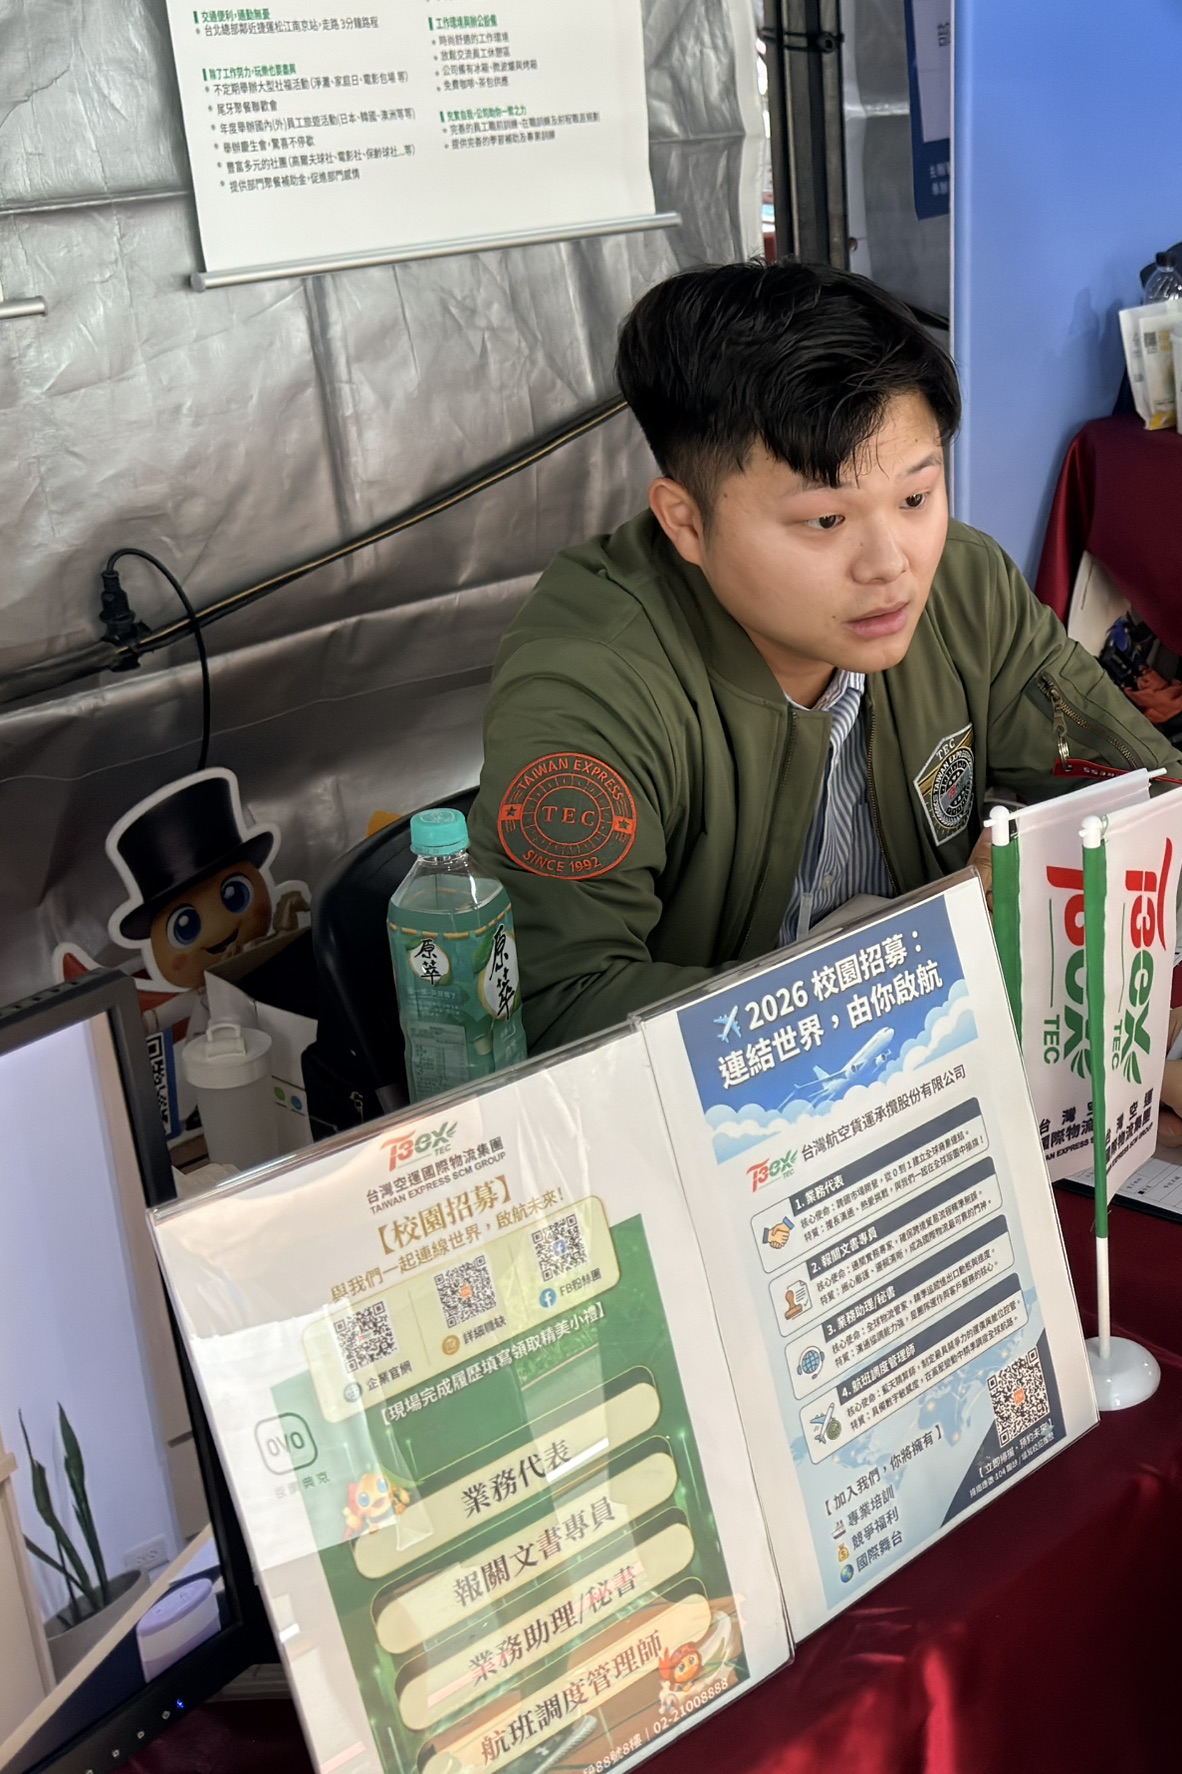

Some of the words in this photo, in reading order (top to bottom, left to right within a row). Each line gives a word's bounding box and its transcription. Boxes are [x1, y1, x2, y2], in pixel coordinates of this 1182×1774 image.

[217, 99, 277, 116] 尾牙聚餐聯歡會
[936, 738, 956, 760] TEC
[518, 758, 569, 792] TAIWAN
[574, 760, 624, 800] EXPRESS
[542, 806, 596, 827] TEC
[522, 850, 565, 872] SINCE
[569, 857, 602, 873] 1992
[414, 938, 441, 985] 原萃
[743, 978, 810, 1031] 2026
[809, 926, 924, 1004] 校園招募：
[716, 956, 943, 1091] 連結世界，由你啟航
[1042, 1015, 1060, 1065] TEC
[1111, 1019, 1122, 1071] TEC
[800, 1062, 966, 1163] 台灣航空貨運承攬股份有限公司
[365, 1135, 503, 1206] 台灣空運國際物流集團
[433, 1142, 453, 1157] TEC
[1057, 1139, 1089, 1157] EXPRESS
[369, 1192, 407, 1215] TAIWAN
[407, 1173, 451, 1199] EXPRESS
[451, 1164, 473, 1180] SCM
[474, 1149, 507, 1171] GROUP
[804, 1172, 845, 1206] 業務代表
[377, 1173, 512, 1256] 【校園招募】
[809, 1258, 821, 1275] 2.
[820, 1224, 878, 1269] 報關文書專員
[558, 1267, 602, 1297] FB粉絲團
[462, 1313, 507, 1345] 詳細職缺
[825, 1320, 837, 1338] 3.
[365, 1358, 412, 1391] 企業官網
[840, 1383, 852, 1401] 4.
[850, 1340, 917, 1395] 航班調度管理師
[459, 1435, 572, 1519] 業務代表
[845, 1483, 895, 1531] 專業培訓
[850, 1504, 899, 1552] 競爭福利
[451, 1494, 616, 1609] 報關文書專員
[854, 1525, 904, 1575] 國際舞台
[468, 1562, 639, 1686] 業務助理/秘書
[478, 1628, 665, 1765] 航班調度管理師
[653, 1678, 728, 1735] 02-21008888
